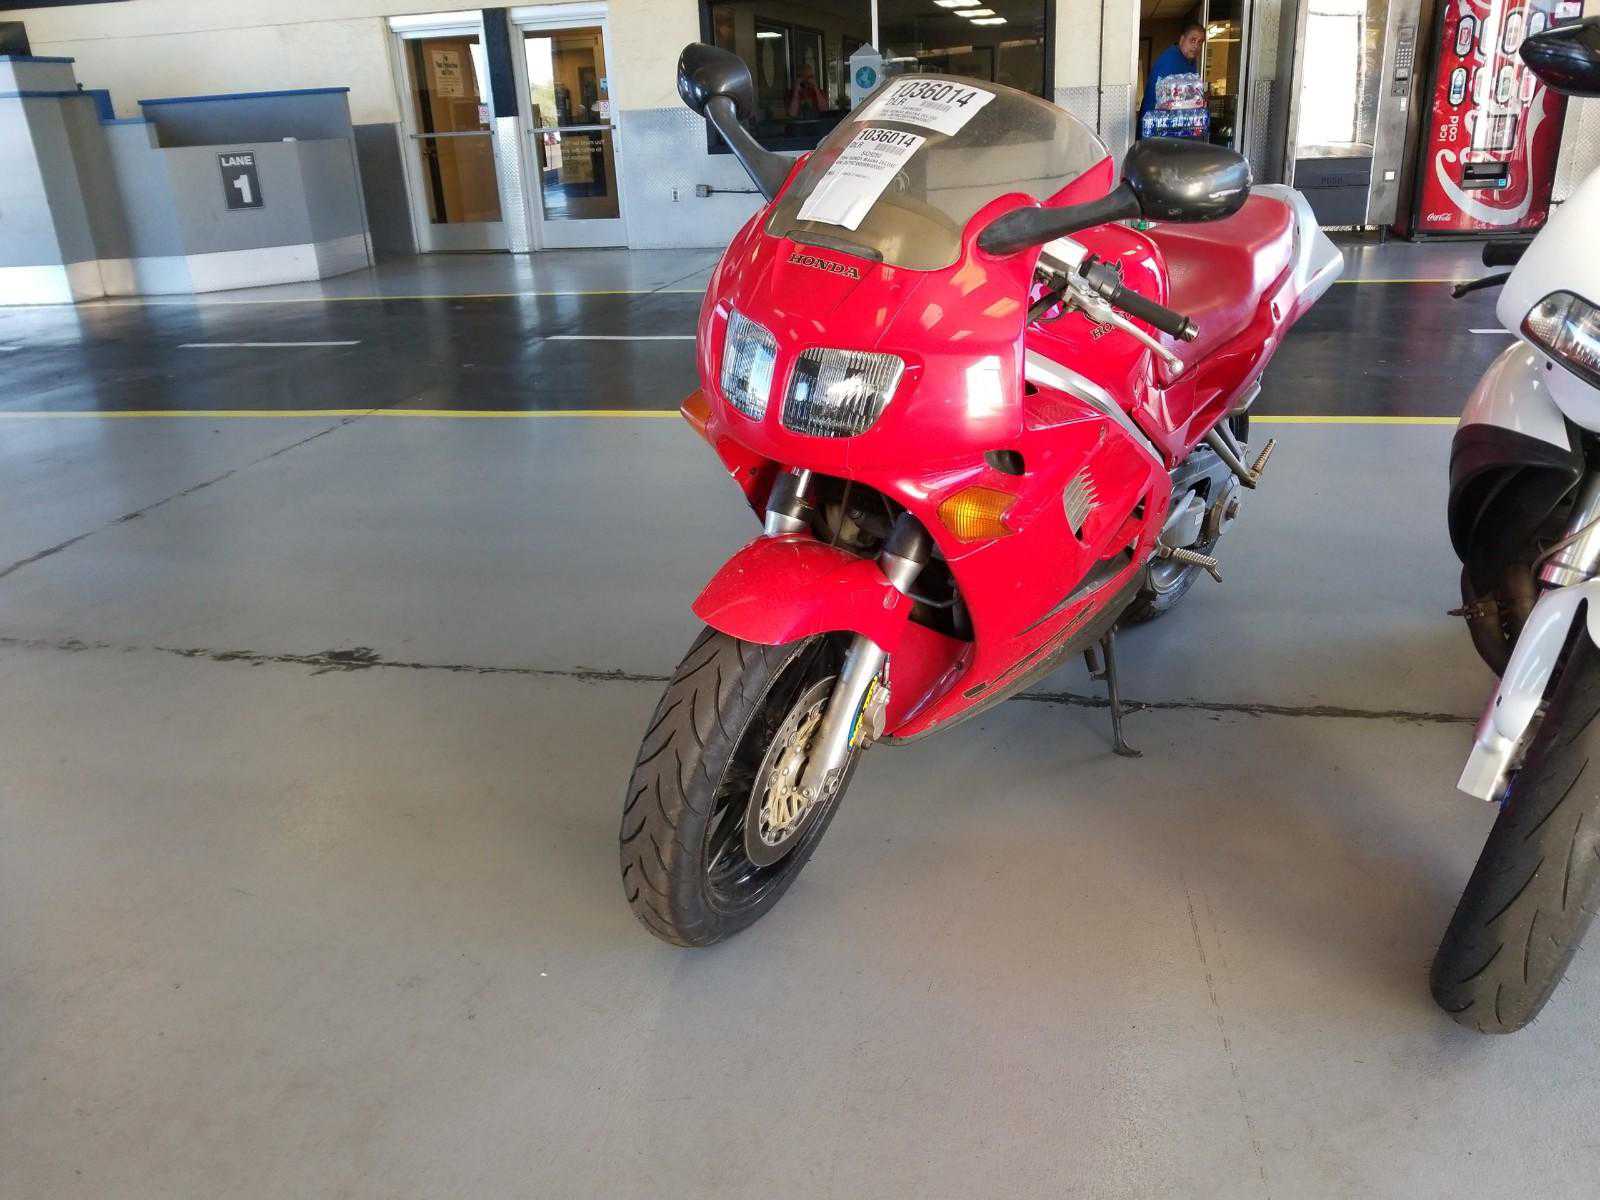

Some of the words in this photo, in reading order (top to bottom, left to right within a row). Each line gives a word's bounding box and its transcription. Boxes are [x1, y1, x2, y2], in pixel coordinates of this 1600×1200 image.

[886, 97, 907, 106] DLR
[891, 82, 977, 108] 1036014
[859, 129, 917, 148] 1036014
[1438, 125, 1448, 142] ice
[1449, 115, 1459, 142] cold
[221, 155, 253, 167] LANE
[233, 174, 253, 203] 1
[788, 252, 861, 280] HONDA
